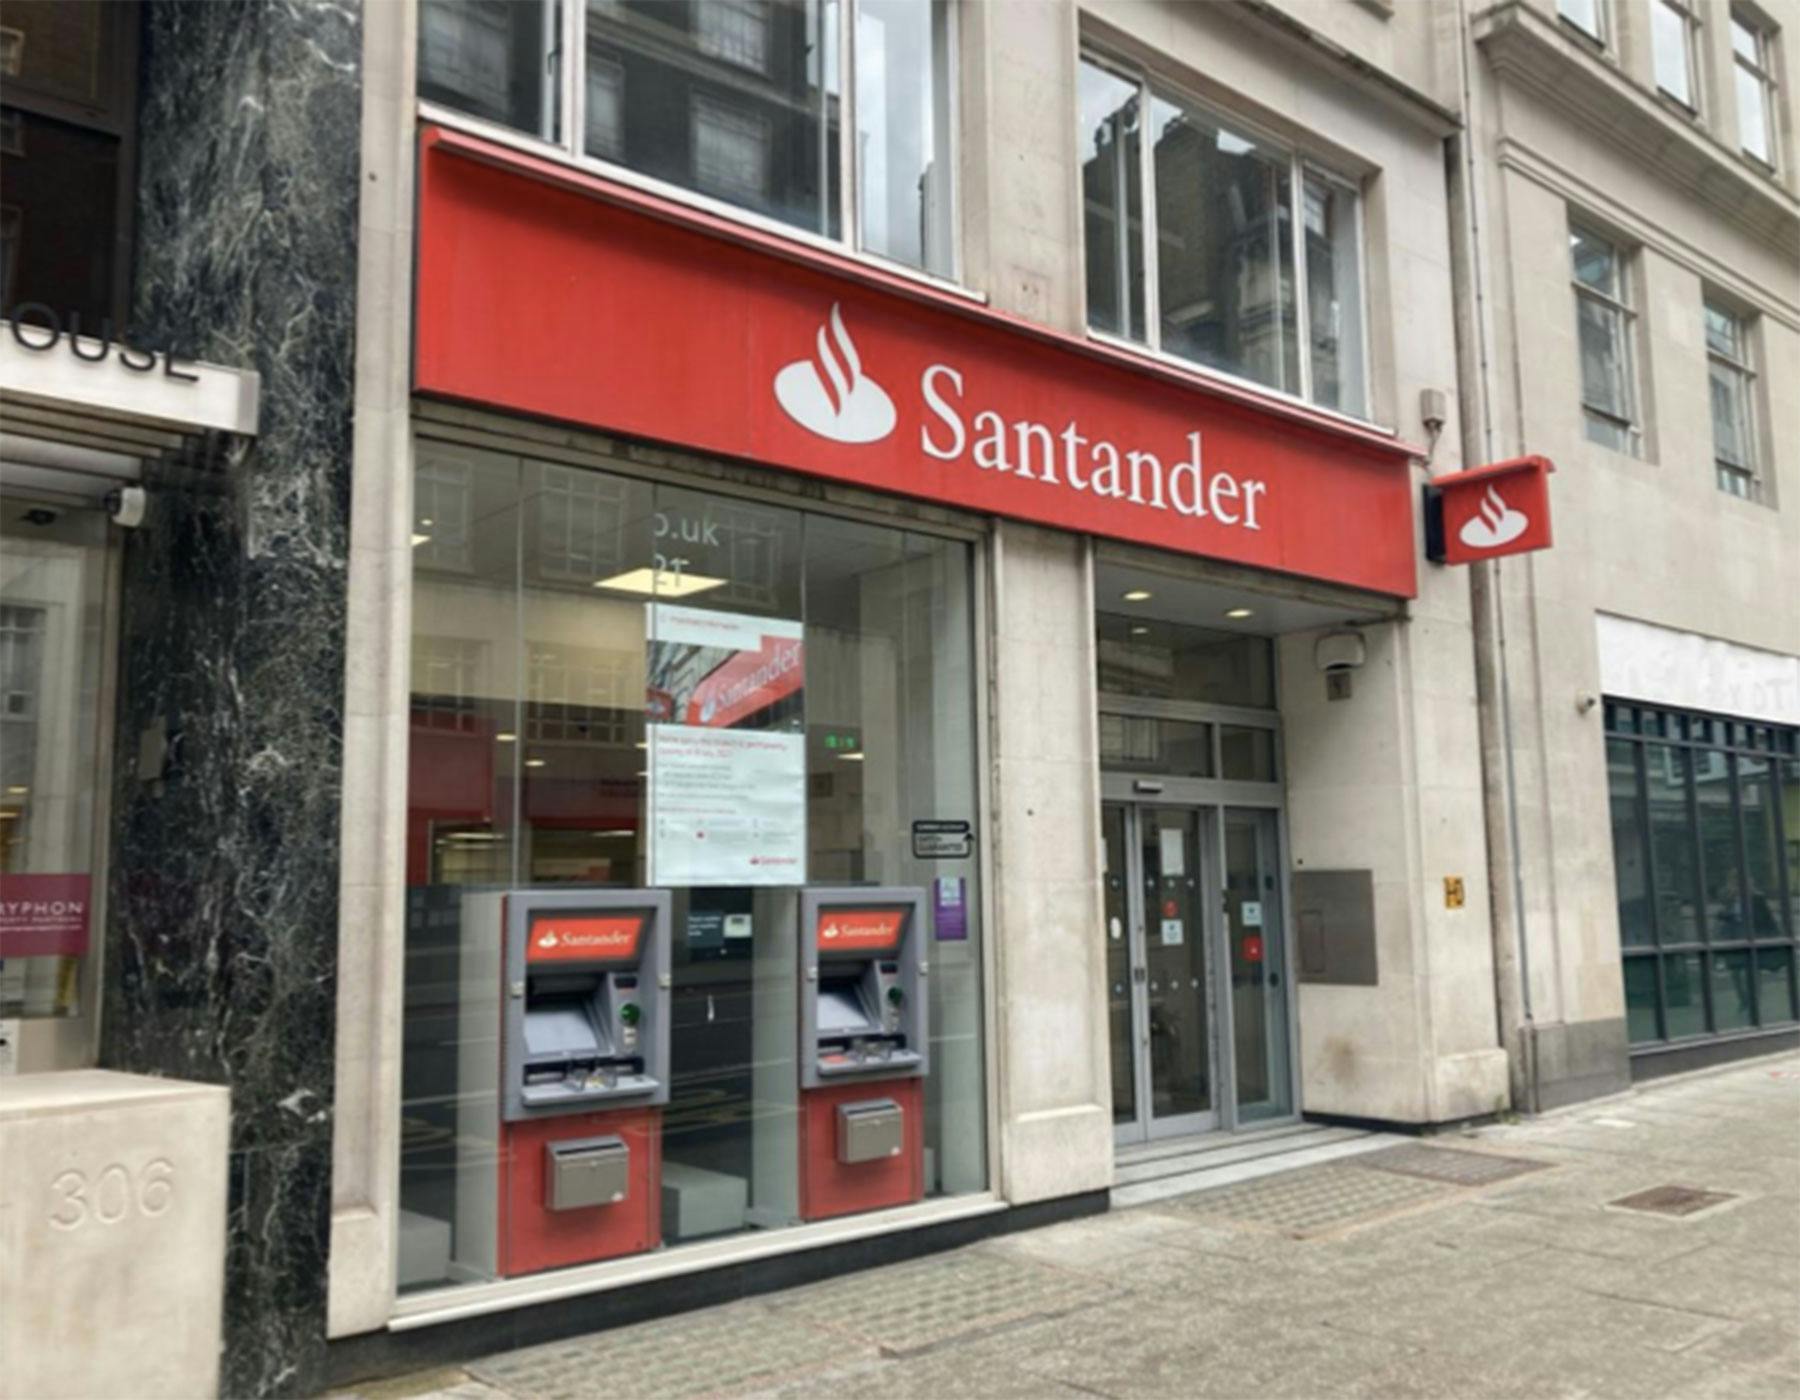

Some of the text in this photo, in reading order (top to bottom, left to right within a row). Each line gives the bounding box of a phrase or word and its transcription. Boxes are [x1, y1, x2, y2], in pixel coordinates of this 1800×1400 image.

[921, 363, 1266, 531] Santander
[560, 930, 632, 947] Santander
[50, 1157, 176, 1232] 306
